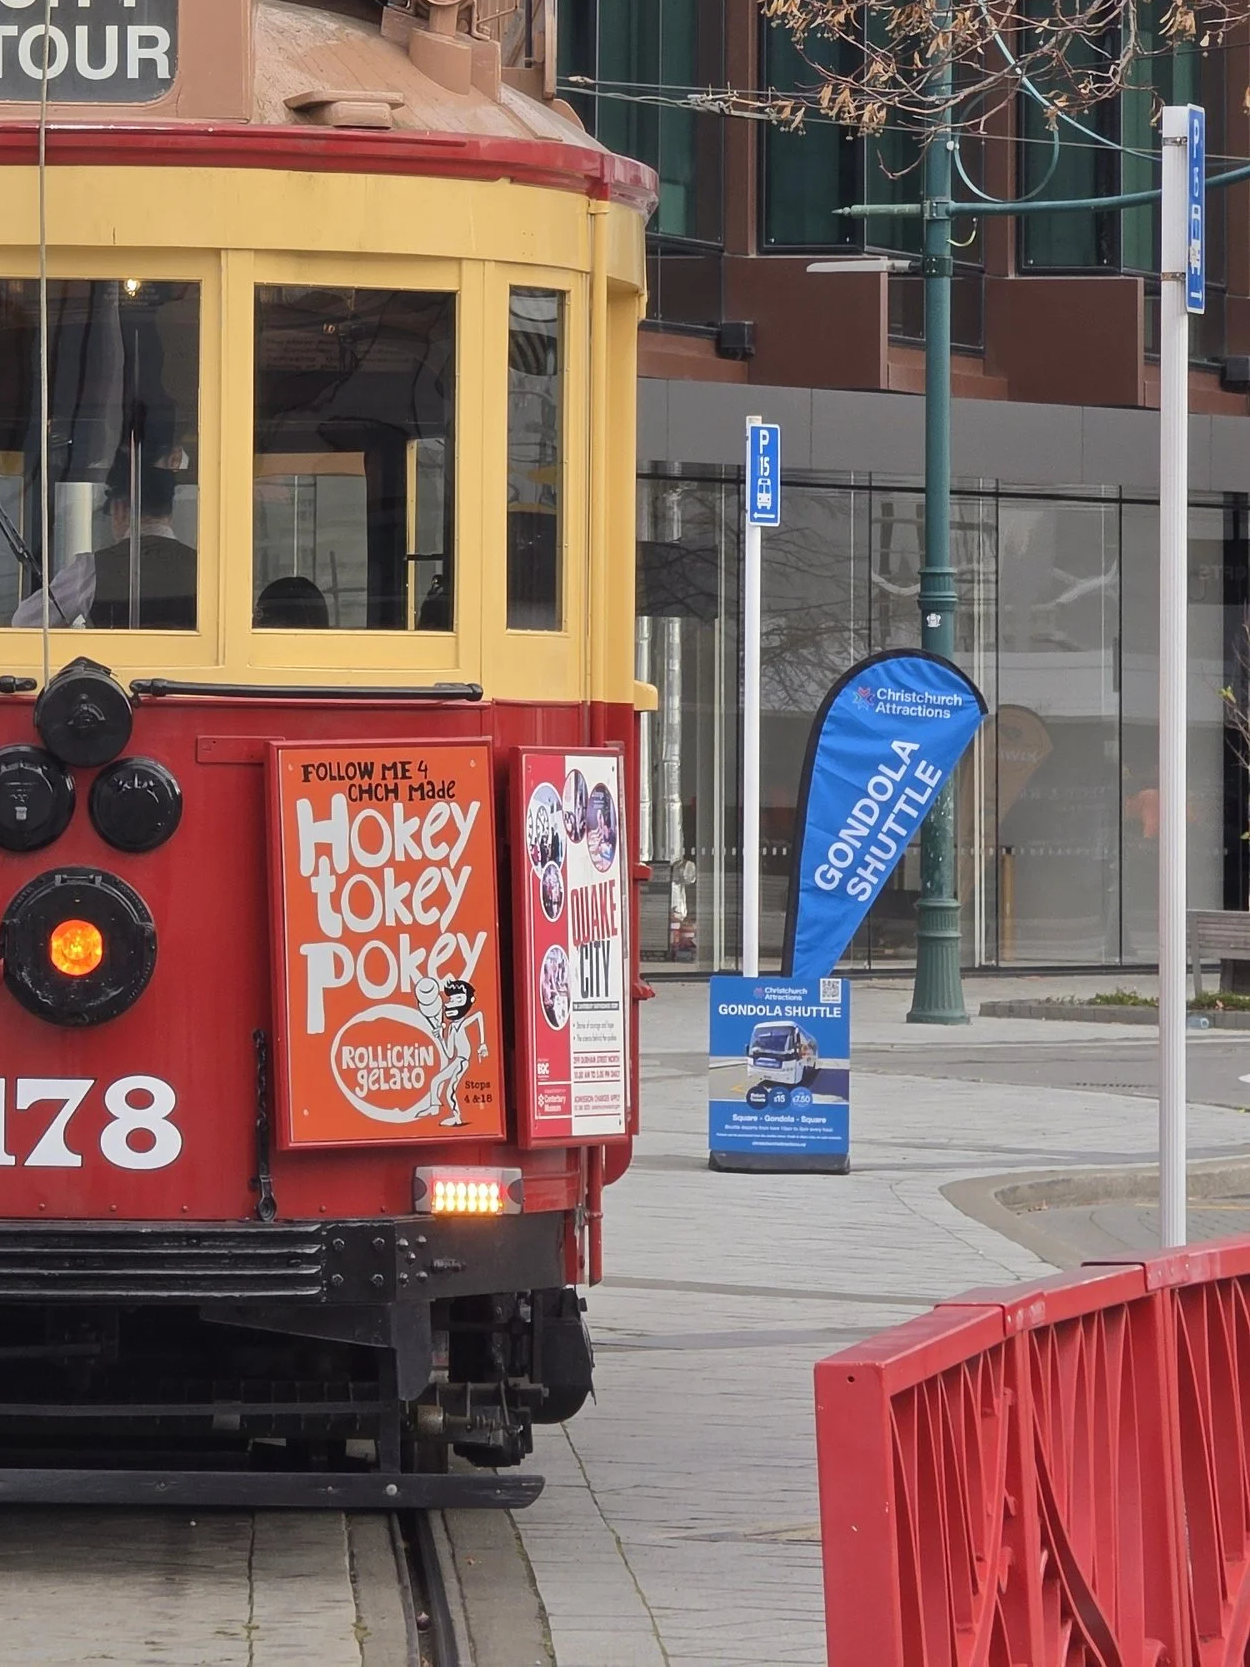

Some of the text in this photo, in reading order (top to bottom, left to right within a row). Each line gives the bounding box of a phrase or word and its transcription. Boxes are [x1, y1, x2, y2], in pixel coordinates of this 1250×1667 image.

[760, 430, 769, 454] P
[760, 456, 769, 476] 15
[877, 688, 962, 706] Christchurch
[875, 702, 950, 719] Attractions
[301, 760, 428, 783] FOLLOW ME 4
[348, 783, 398, 802] CHCH
[814, 740, 920, 891] GONDOLA
[846, 760, 943, 902] SHUTTLE
[571, 880, 617, 950] QUAKE
[580, 941, 610, 999] CITY
[765, 987, 807, 995] Christchurch
[719, 1004, 841, 1018] GONDOLA SHUTTLE
[465, 1080, 490, 1090] Stops
[464, 1095, 470, 1103] 4
[801, 1116, 826, 1124] Square
